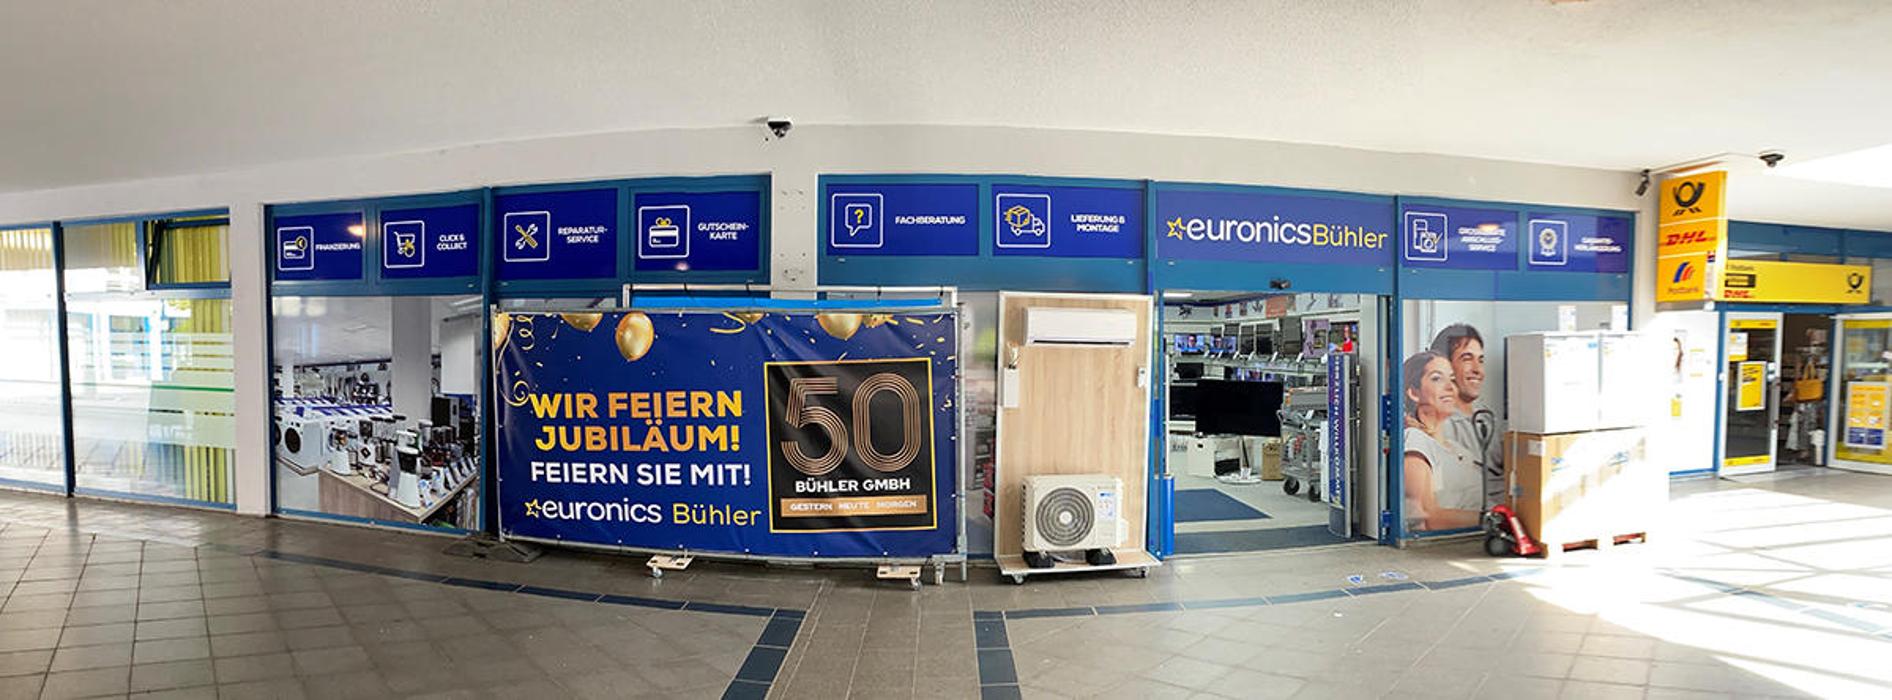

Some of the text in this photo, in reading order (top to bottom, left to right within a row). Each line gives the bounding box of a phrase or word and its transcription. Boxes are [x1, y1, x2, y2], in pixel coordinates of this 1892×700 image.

[894, 215, 966, 225] FACHBERATUNG
[1070, 214, 1116, 223] LIEFERUNG
[557, 226, 608, 235] REPARATUR-
[697, 222, 749, 232] GUTSCHEIN-
[1076, 223, 1120, 233] MONTAGE
[439, 234, 457, 243] CLICK
[566, 235, 599, 244] SERVICE
[709, 231, 737, 240] KARTE
[1665, 230, 1708, 246] DHL
[436, 242, 467, 250] COLLECT
[529, 390, 743, 419] WIR FEIERN
[780, 372, 923, 476] 50
[535, 419, 741, 452] JUBILÄUM!
[530, 461, 752, 486] FEIERN SIE MIT!
[795, 477, 911, 493] BÜHLER GMBH
[790, 500, 917, 511] GESTERN HEUTE MORGEN
[541, 498, 762, 526] euronics Bühler
